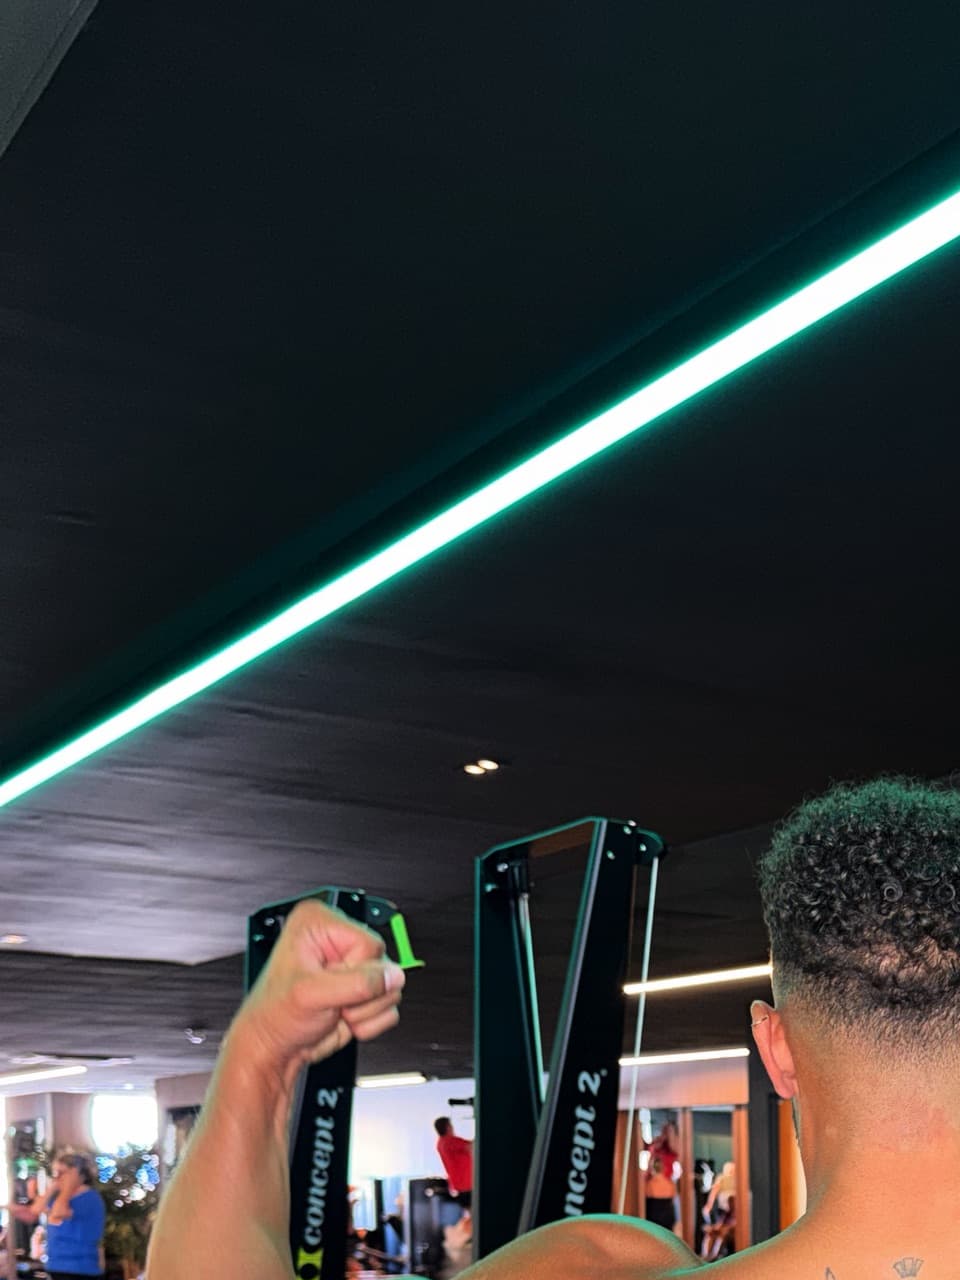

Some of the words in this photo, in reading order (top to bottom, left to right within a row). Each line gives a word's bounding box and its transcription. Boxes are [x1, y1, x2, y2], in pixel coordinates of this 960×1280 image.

[317, 1087, 338, 1109] 2
[577, 1070, 601, 1096] 2
[303, 1116, 335, 1246] concept
[563, 1103, 597, 1217] ncept
